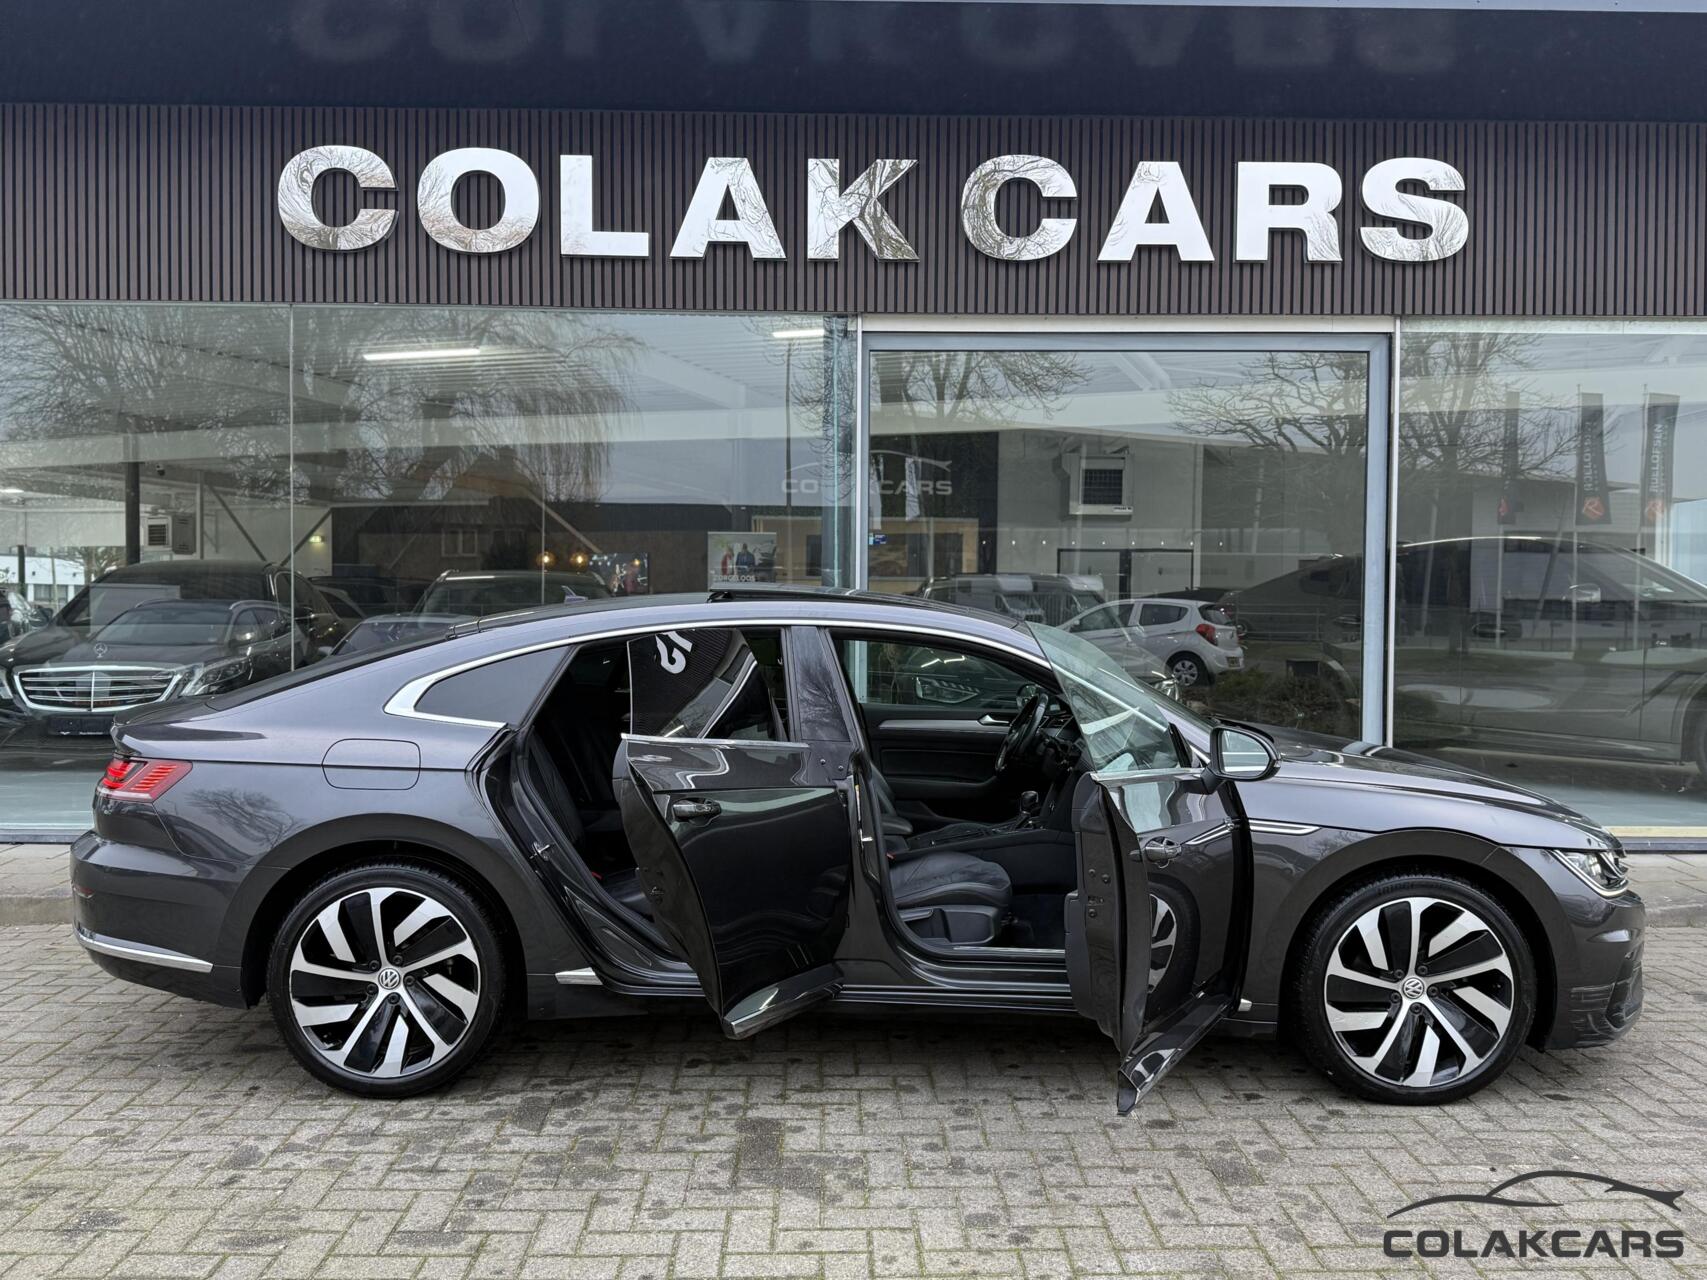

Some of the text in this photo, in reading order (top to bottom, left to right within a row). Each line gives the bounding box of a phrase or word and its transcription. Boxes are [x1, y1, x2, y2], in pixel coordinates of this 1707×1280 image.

[278, 145, 1470, 264] COLAK CARS
[781, 479, 953, 496] COCARS
